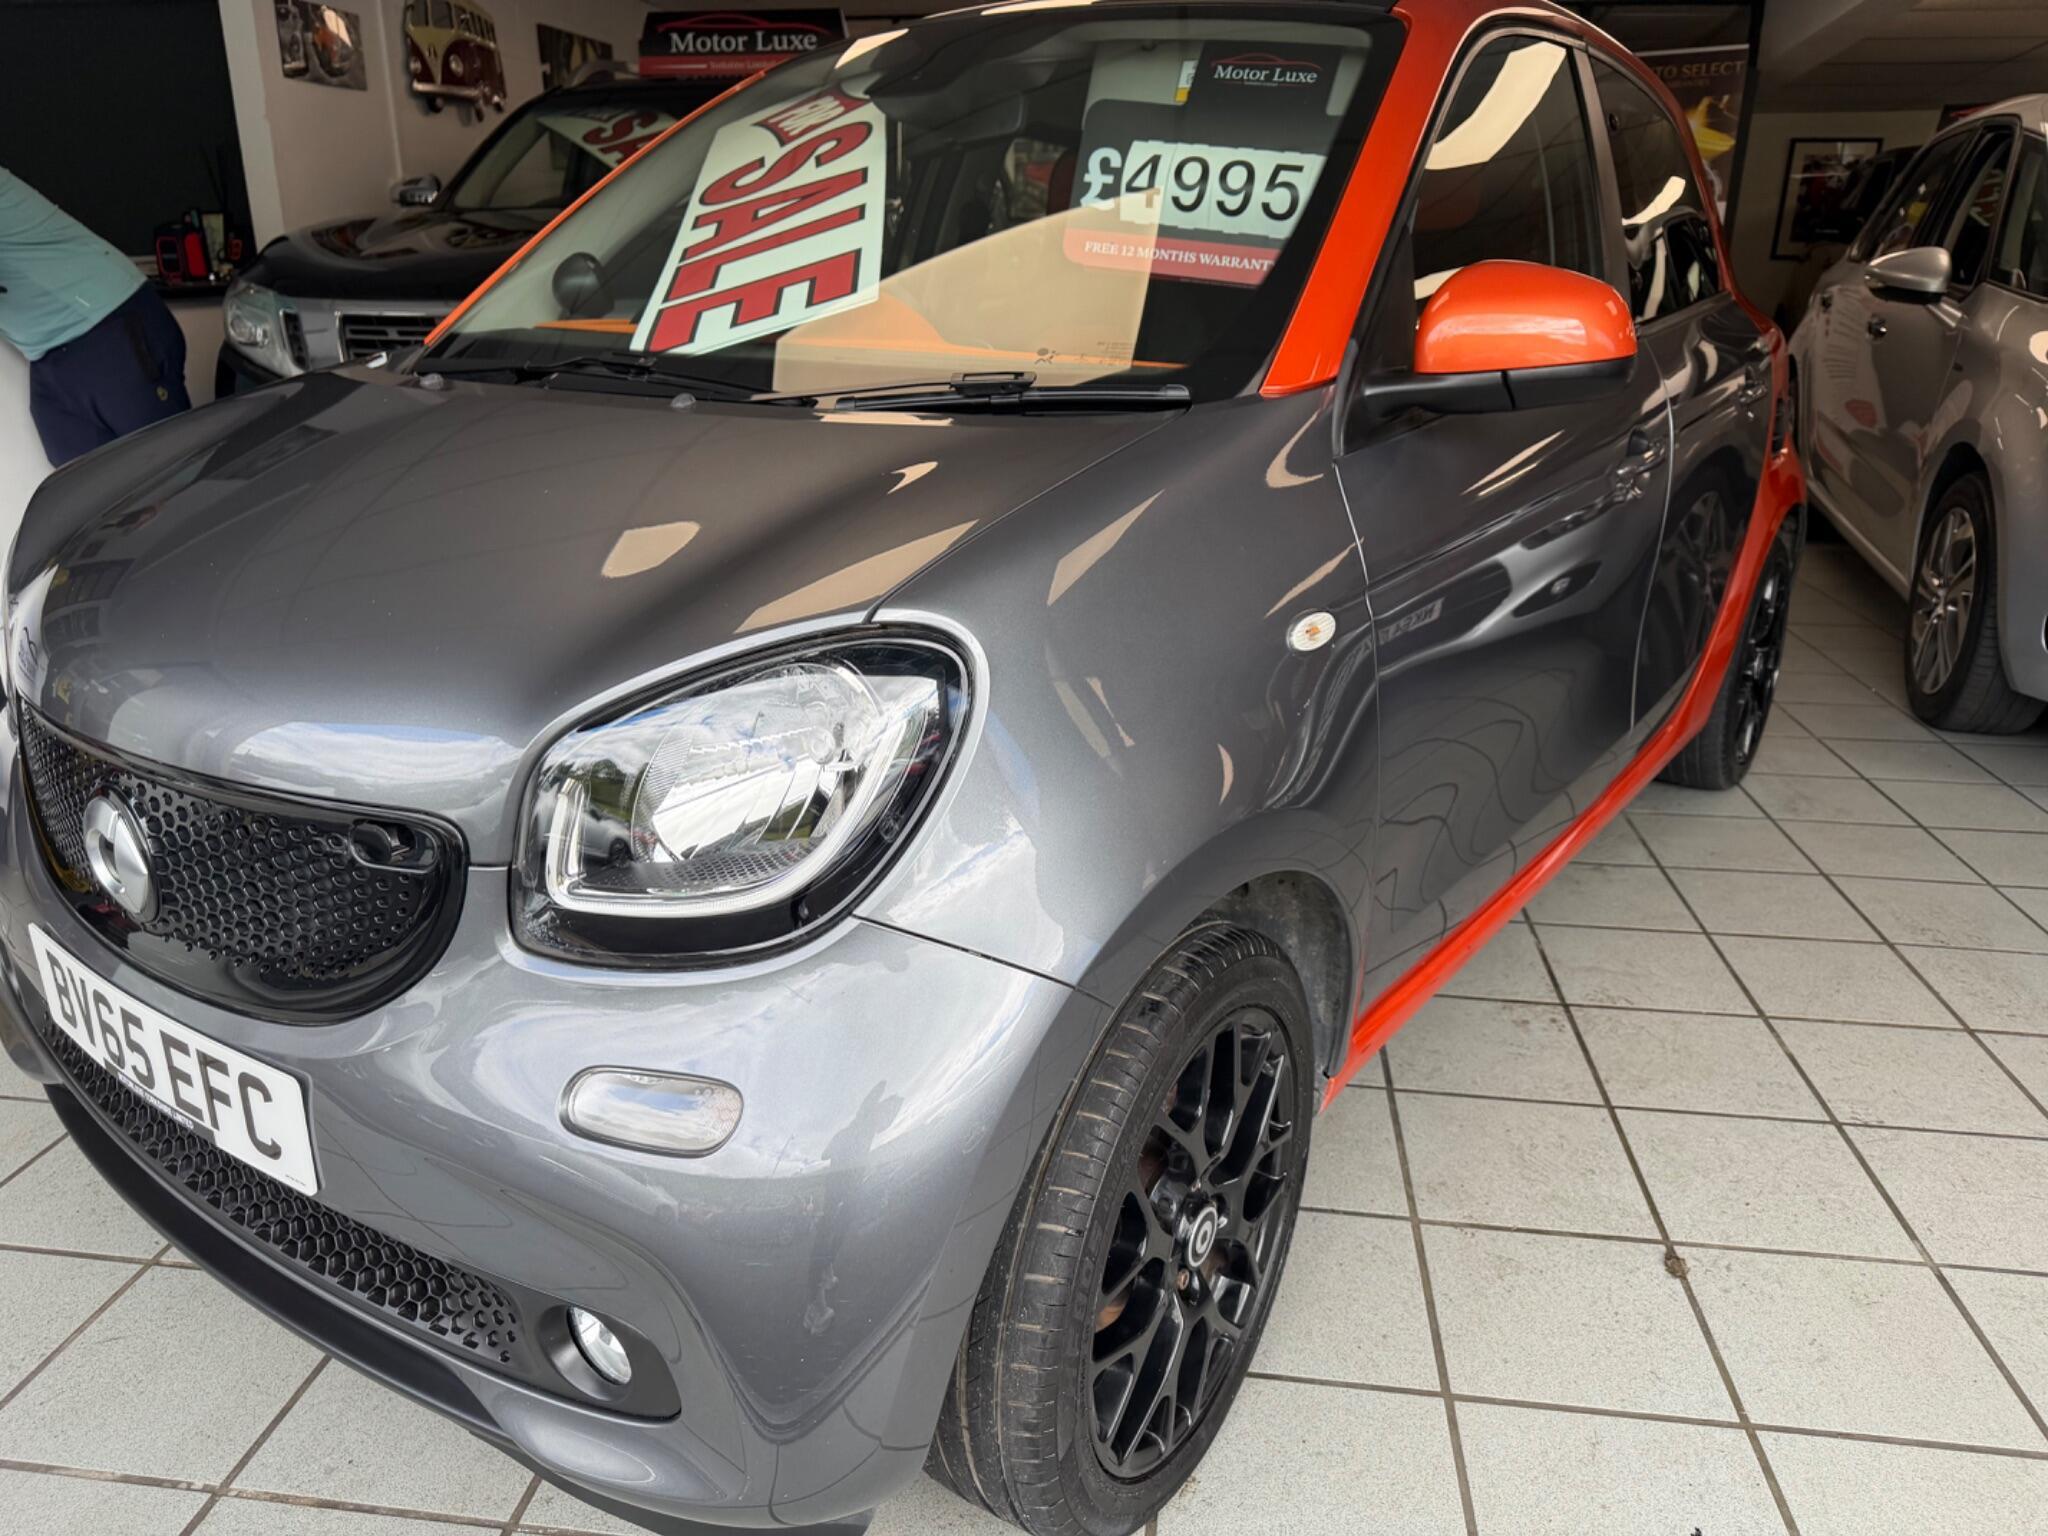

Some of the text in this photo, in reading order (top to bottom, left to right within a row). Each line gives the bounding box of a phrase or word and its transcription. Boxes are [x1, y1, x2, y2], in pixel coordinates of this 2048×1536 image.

[669, 30, 818, 53] Motor Luxe
[1213, 65, 1318, 83] Motor Luxe
[1681, 61, 1745, 78] SELECT
[767, 95, 846, 137] FOR
[1080, 147, 1304, 222] £4995
[643, 121, 873, 353] SALE
[1084, 241, 1276, 272] FREE 12 MONTHS WARRANT
[45, 948, 156, 1090] BV65
[158, 1029, 282, 1161] EFC
